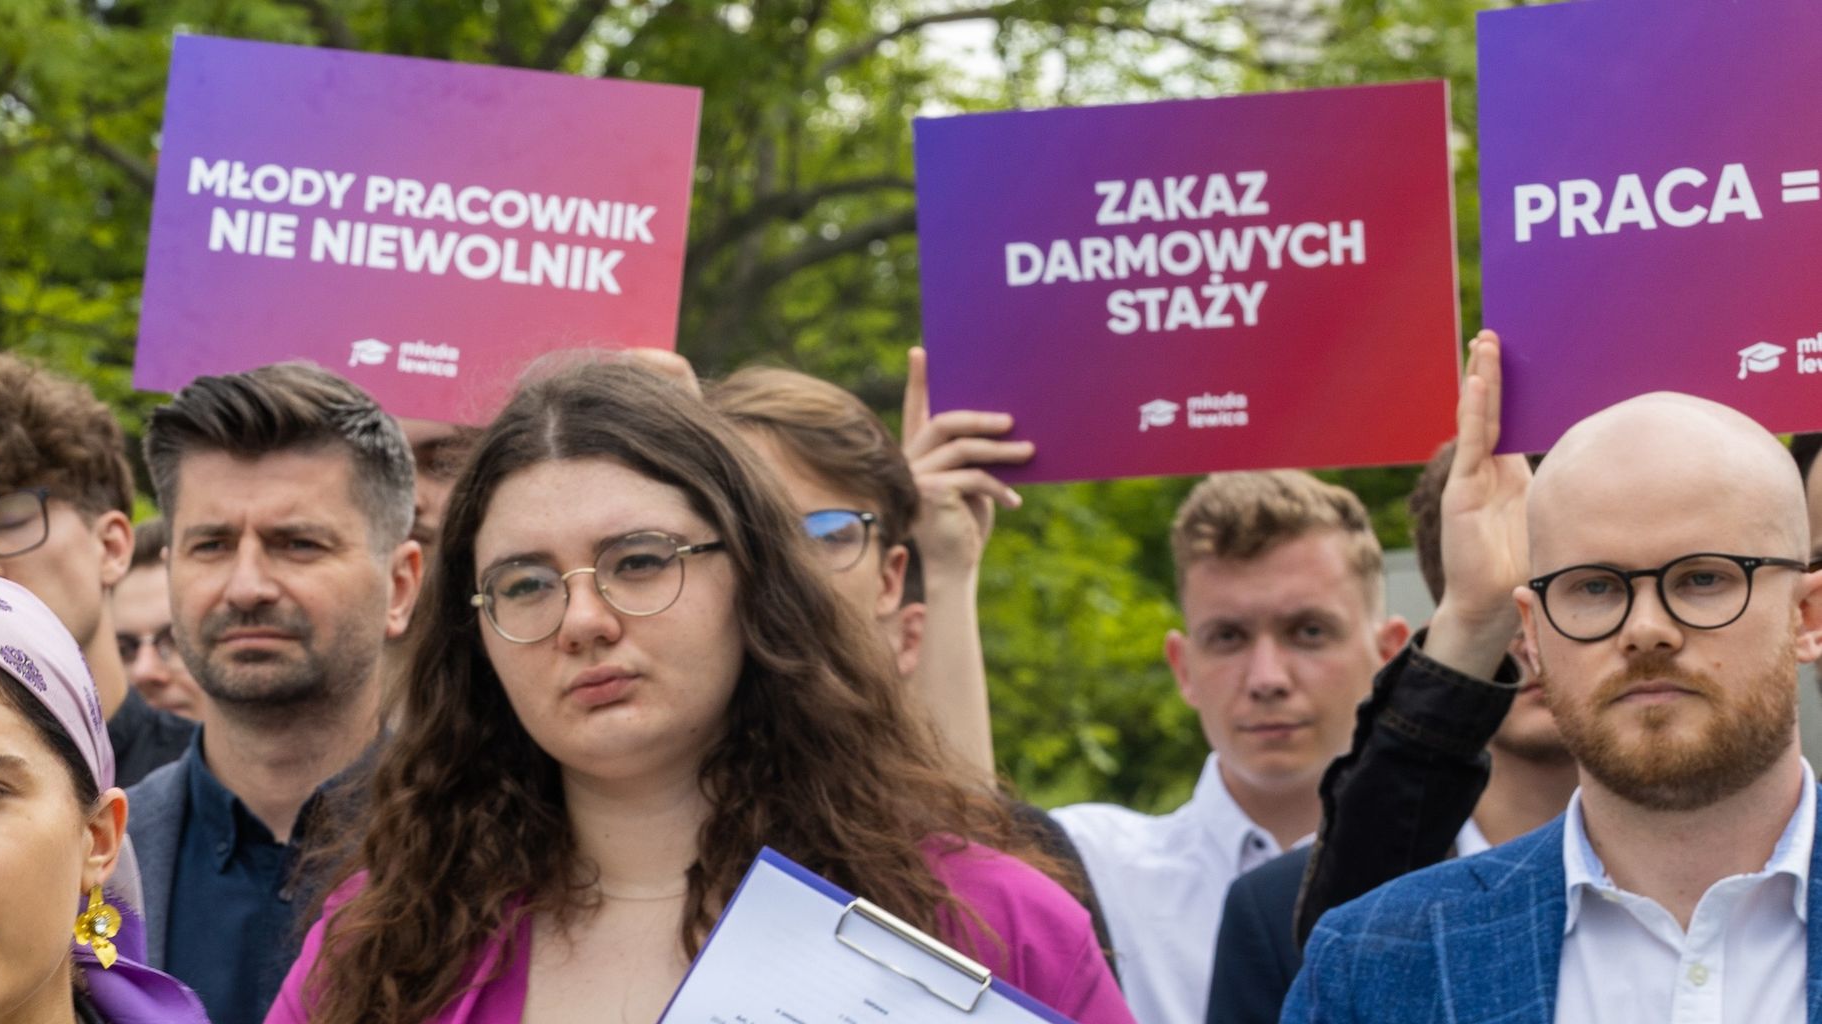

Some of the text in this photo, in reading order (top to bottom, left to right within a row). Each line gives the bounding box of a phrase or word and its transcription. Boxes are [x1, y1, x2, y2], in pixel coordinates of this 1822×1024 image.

[187, 157, 657, 244] MŁODY PRACOWNIK
[1094, 170, 1270, 226] ZAKAZ
[1513, 163, 1764, 243] PRACA
[208, 207, 625, 296] NIE NIEWOLNIK
[1005, 220, 1367, 287] DARMOWYCH
[1106, 273, 1268, 335] STAŻY
